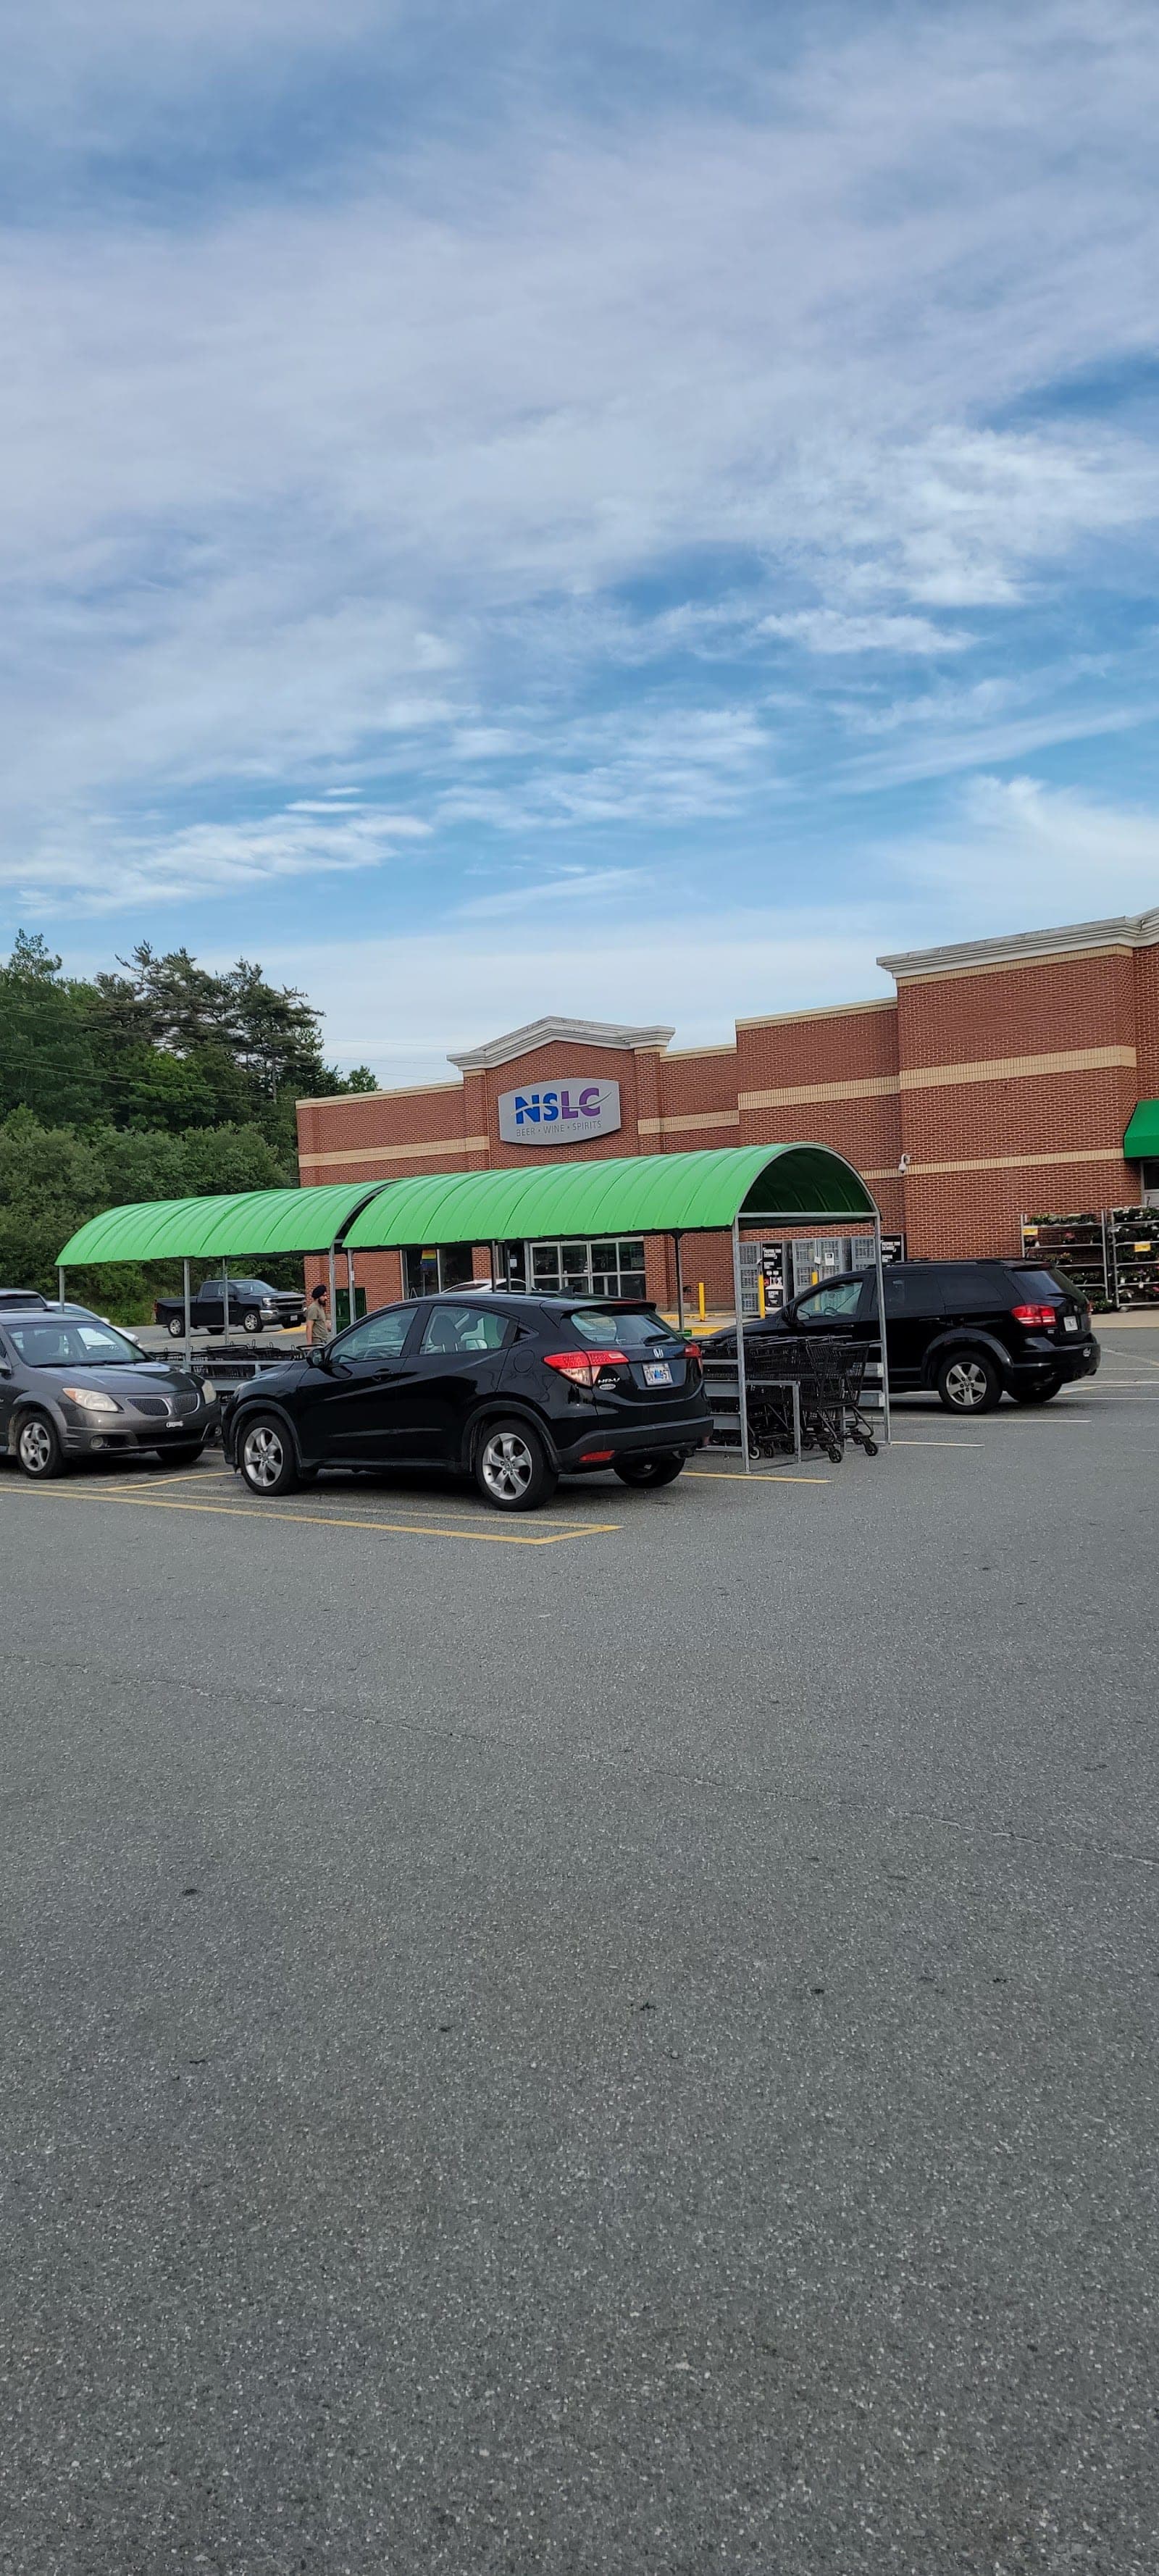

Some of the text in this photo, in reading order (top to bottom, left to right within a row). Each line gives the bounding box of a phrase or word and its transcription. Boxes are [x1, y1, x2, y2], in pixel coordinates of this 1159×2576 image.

[515, 1087, 601, 1124] NSLC
[516, 1120, 602, 1137] BEER WINE SPIRITS
